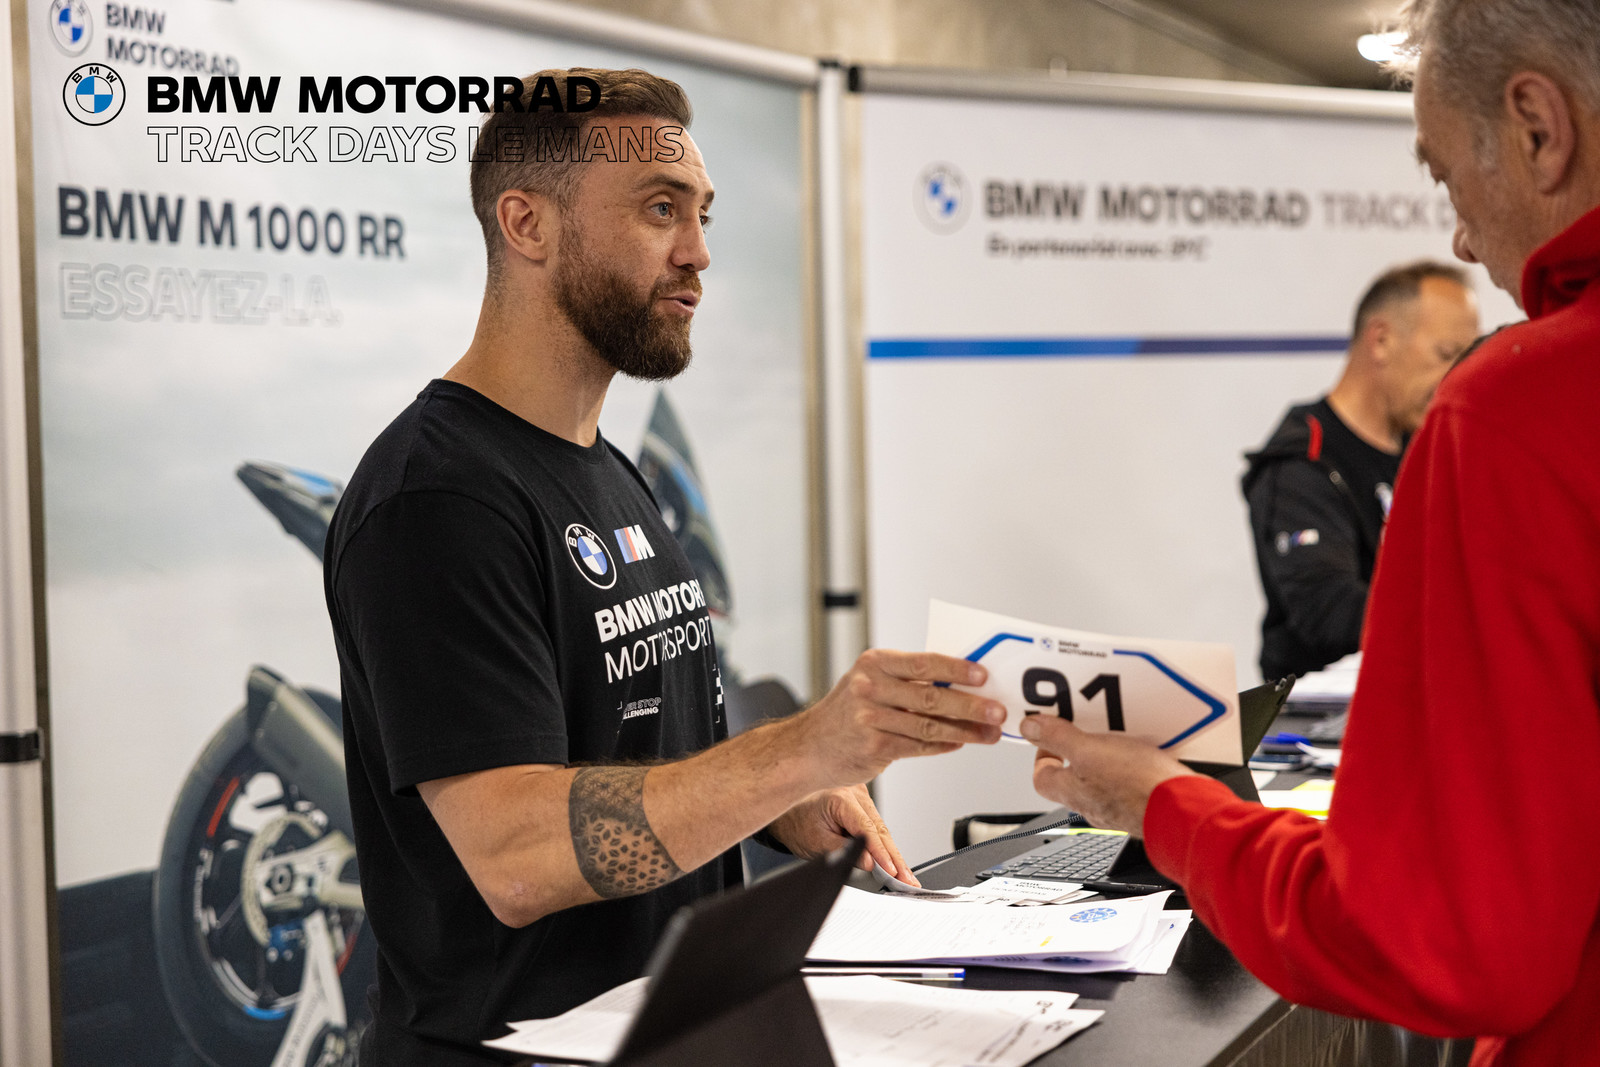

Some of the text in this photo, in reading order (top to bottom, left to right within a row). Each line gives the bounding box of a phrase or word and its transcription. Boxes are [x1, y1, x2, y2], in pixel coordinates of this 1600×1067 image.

[105, 3, 167, 34] BMW
[106, 36, 241, 76] MOTORRAD
[57, 184, 407, 261] BMW M 1000 RR
[984, 180, 1085, 222] BMW
[1098, 182, 1310, 229] MOTORRAD
[1319, 190, 1432, 231] TRACK
[594, 594, 656, 644] BMW
[1021, 667, 1126, 732] 91
